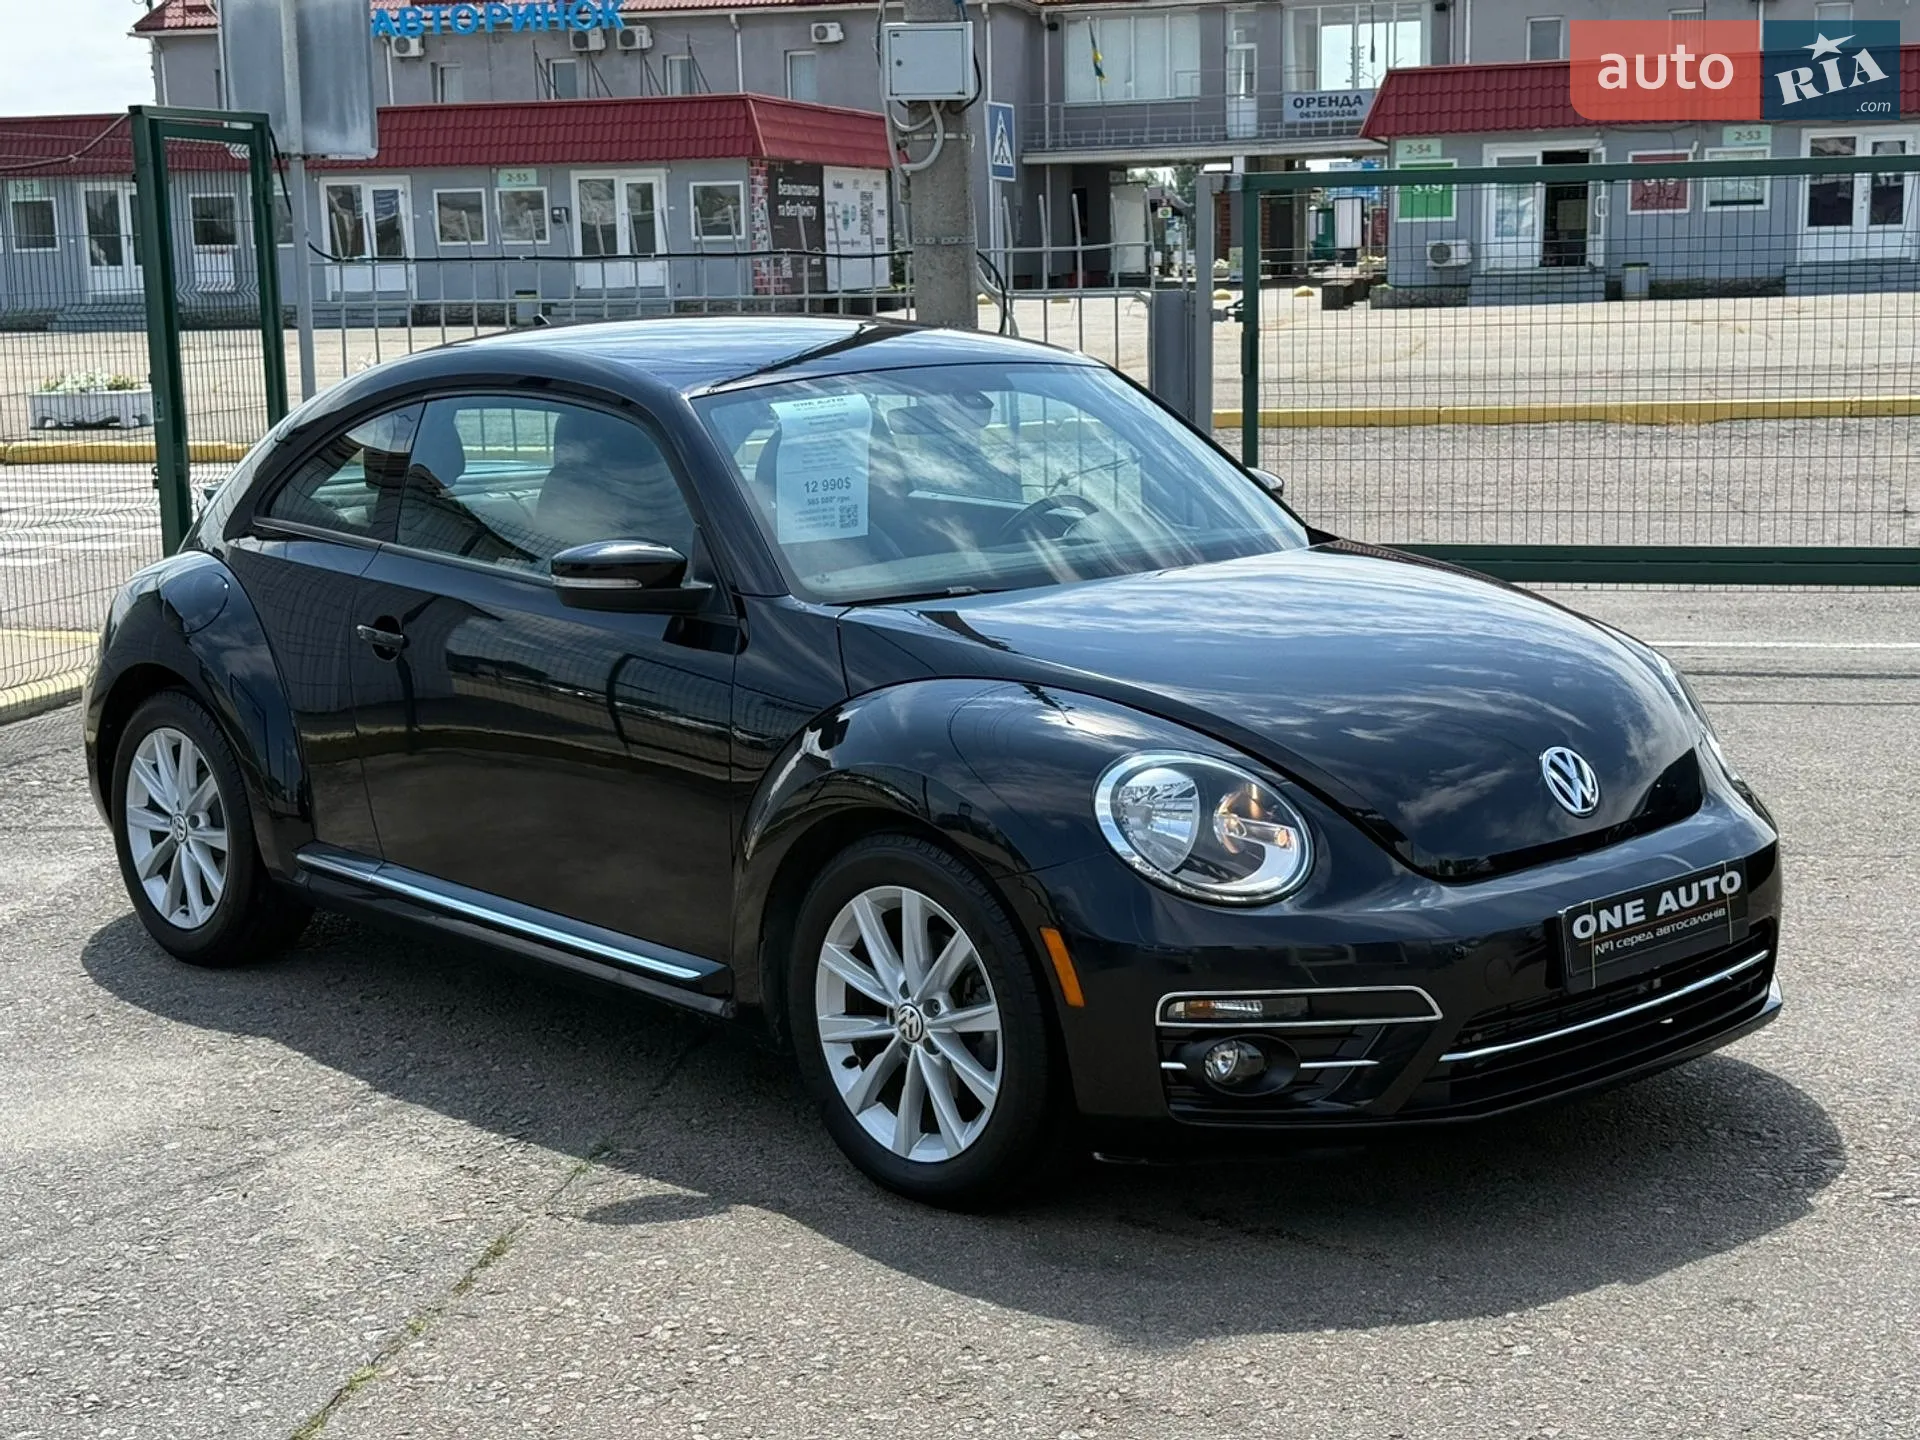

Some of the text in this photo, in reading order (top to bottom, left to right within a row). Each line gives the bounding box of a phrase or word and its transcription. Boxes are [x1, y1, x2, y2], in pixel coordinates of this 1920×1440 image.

[371, 0, 625, 37] АВТОРИНОК
[1293, 95, 1363, 109] ОРЕНДА
[1406, 144, 1432, 155] 2-54
[804, 476, 852, 493] 12 990$
[1572, 871, 1742, 939] ONE AUTO
[1616, 930, 1654, 948] серед
[1656, 907, 1726, 935] автосалонів
